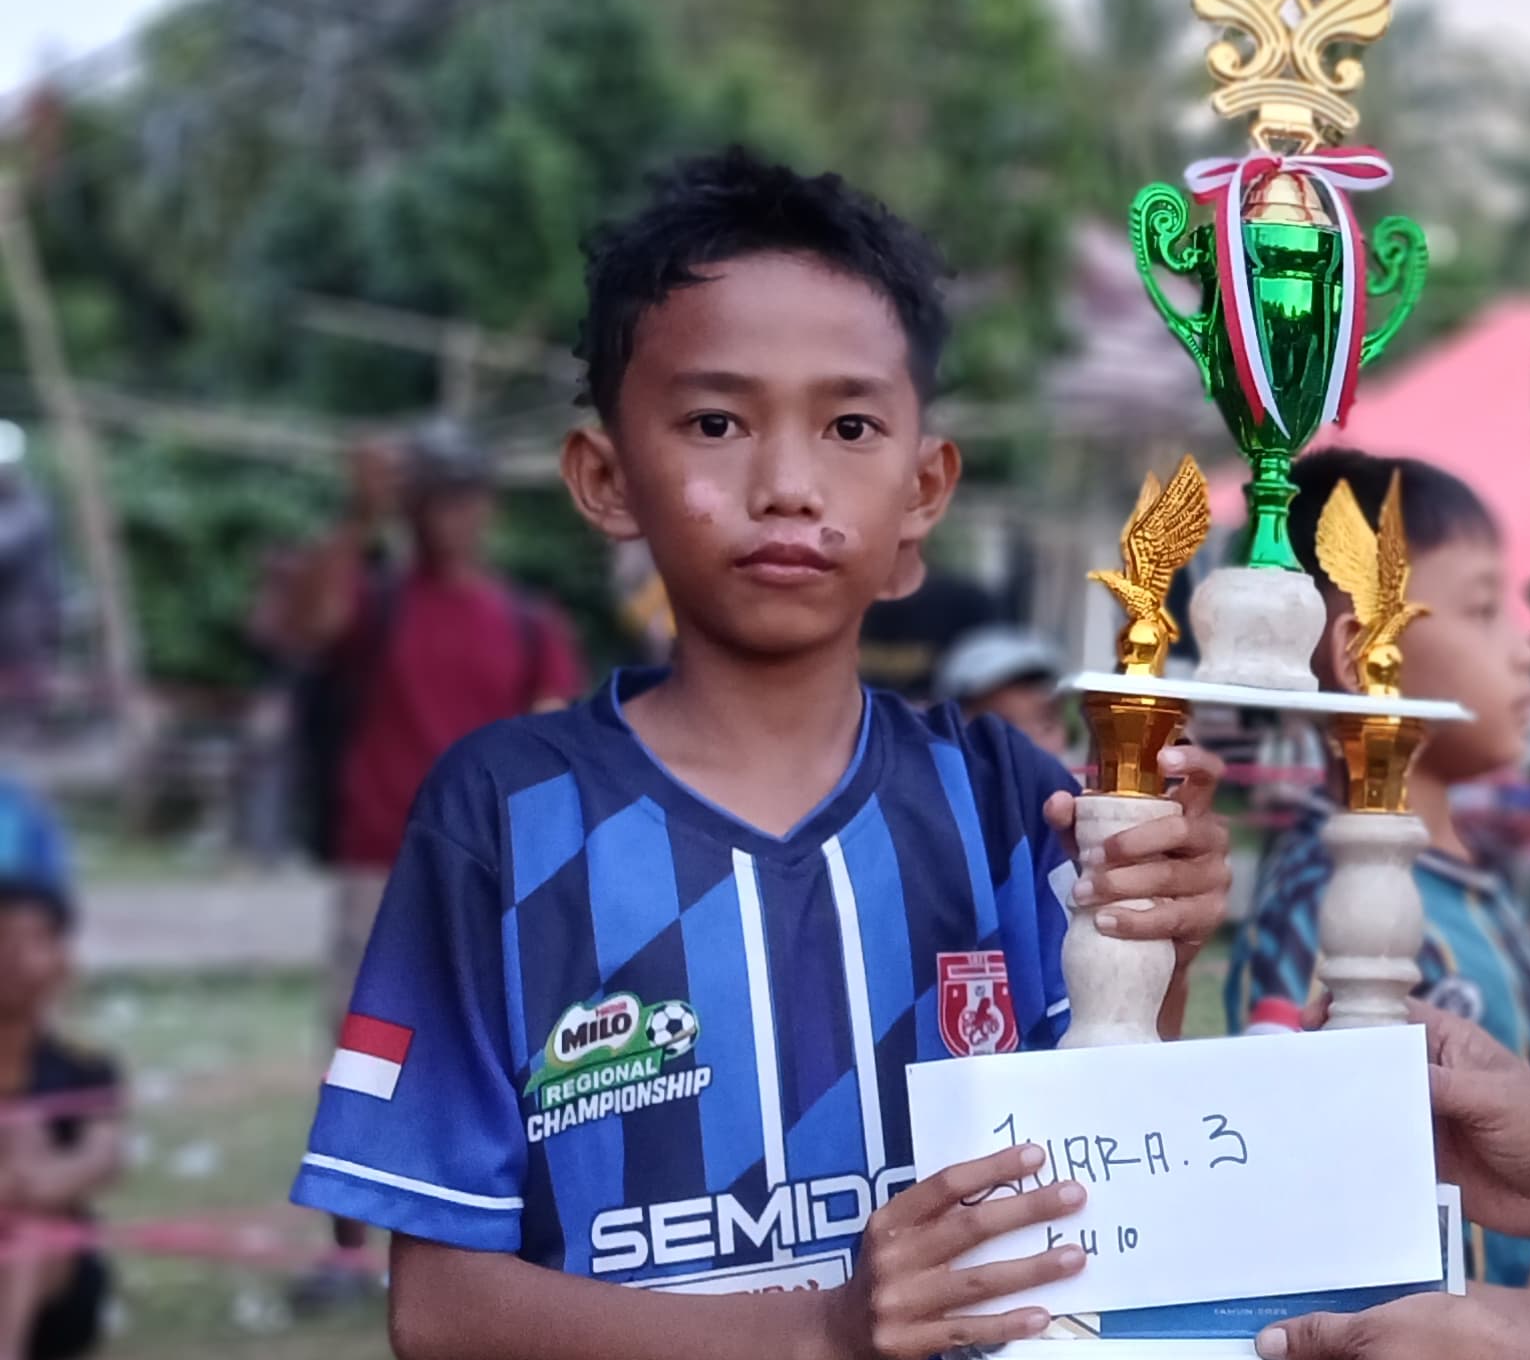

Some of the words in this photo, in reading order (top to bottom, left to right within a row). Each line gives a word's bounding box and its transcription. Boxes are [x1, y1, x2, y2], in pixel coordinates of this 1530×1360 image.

[561, 1012, 633, 1054] MILO
[527, 1066, 712, 1143] CHAMPIONSHIP
[546, 1057, 658, 1106] REGIONAL
